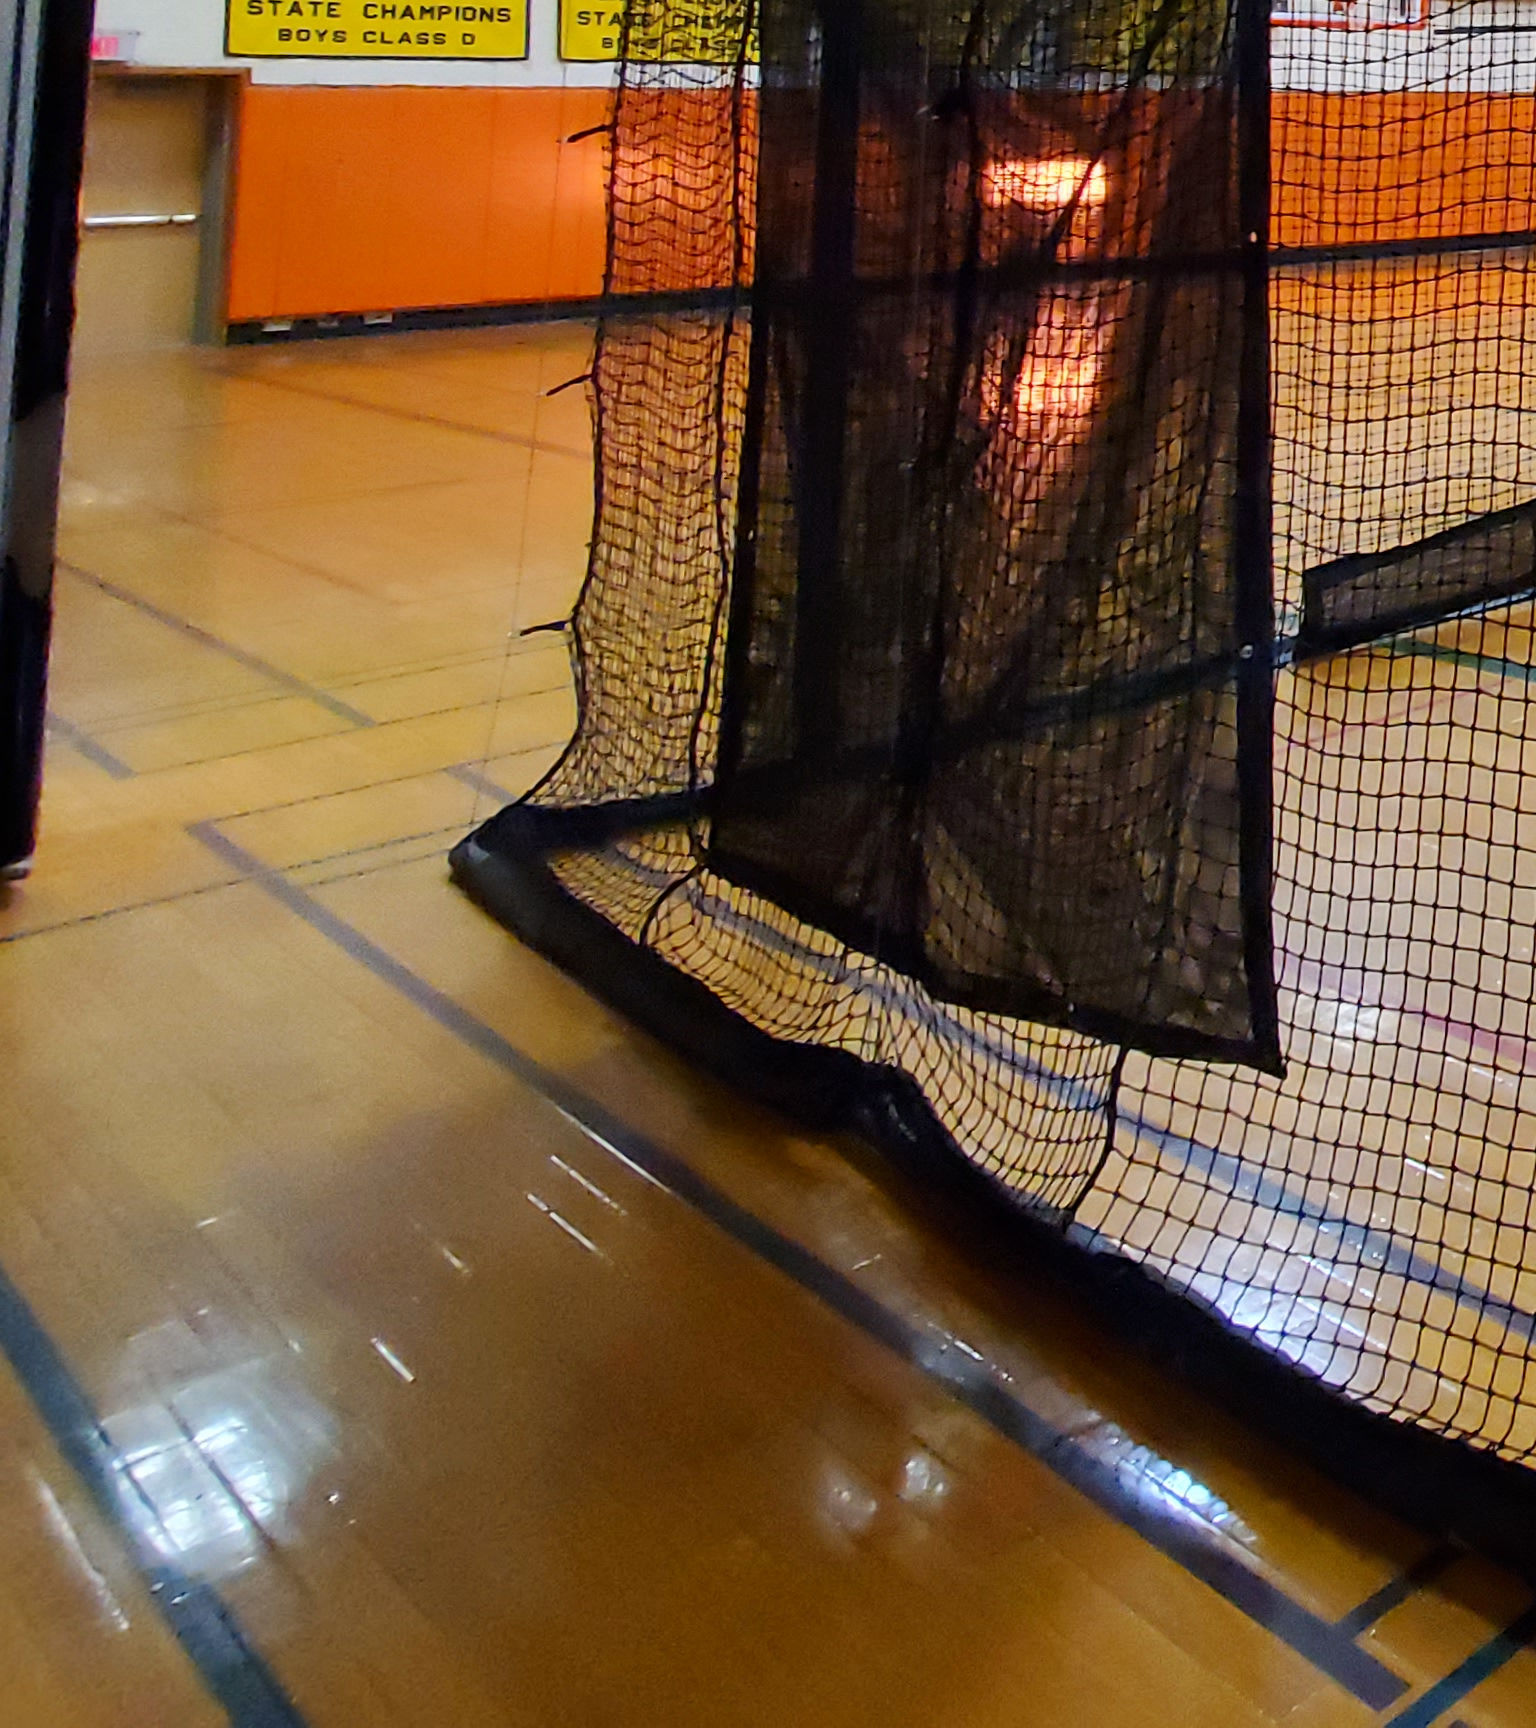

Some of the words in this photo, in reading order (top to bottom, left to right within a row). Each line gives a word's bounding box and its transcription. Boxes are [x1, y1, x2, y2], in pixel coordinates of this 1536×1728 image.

[246, 0, 342, 18] STATE
[362, 3, 512, 23] CHAMPIONS
[277, 28, 347, 43] BOYS
[362, 30, 447, 45] CLASS
[462, 33, 476, 46] D
